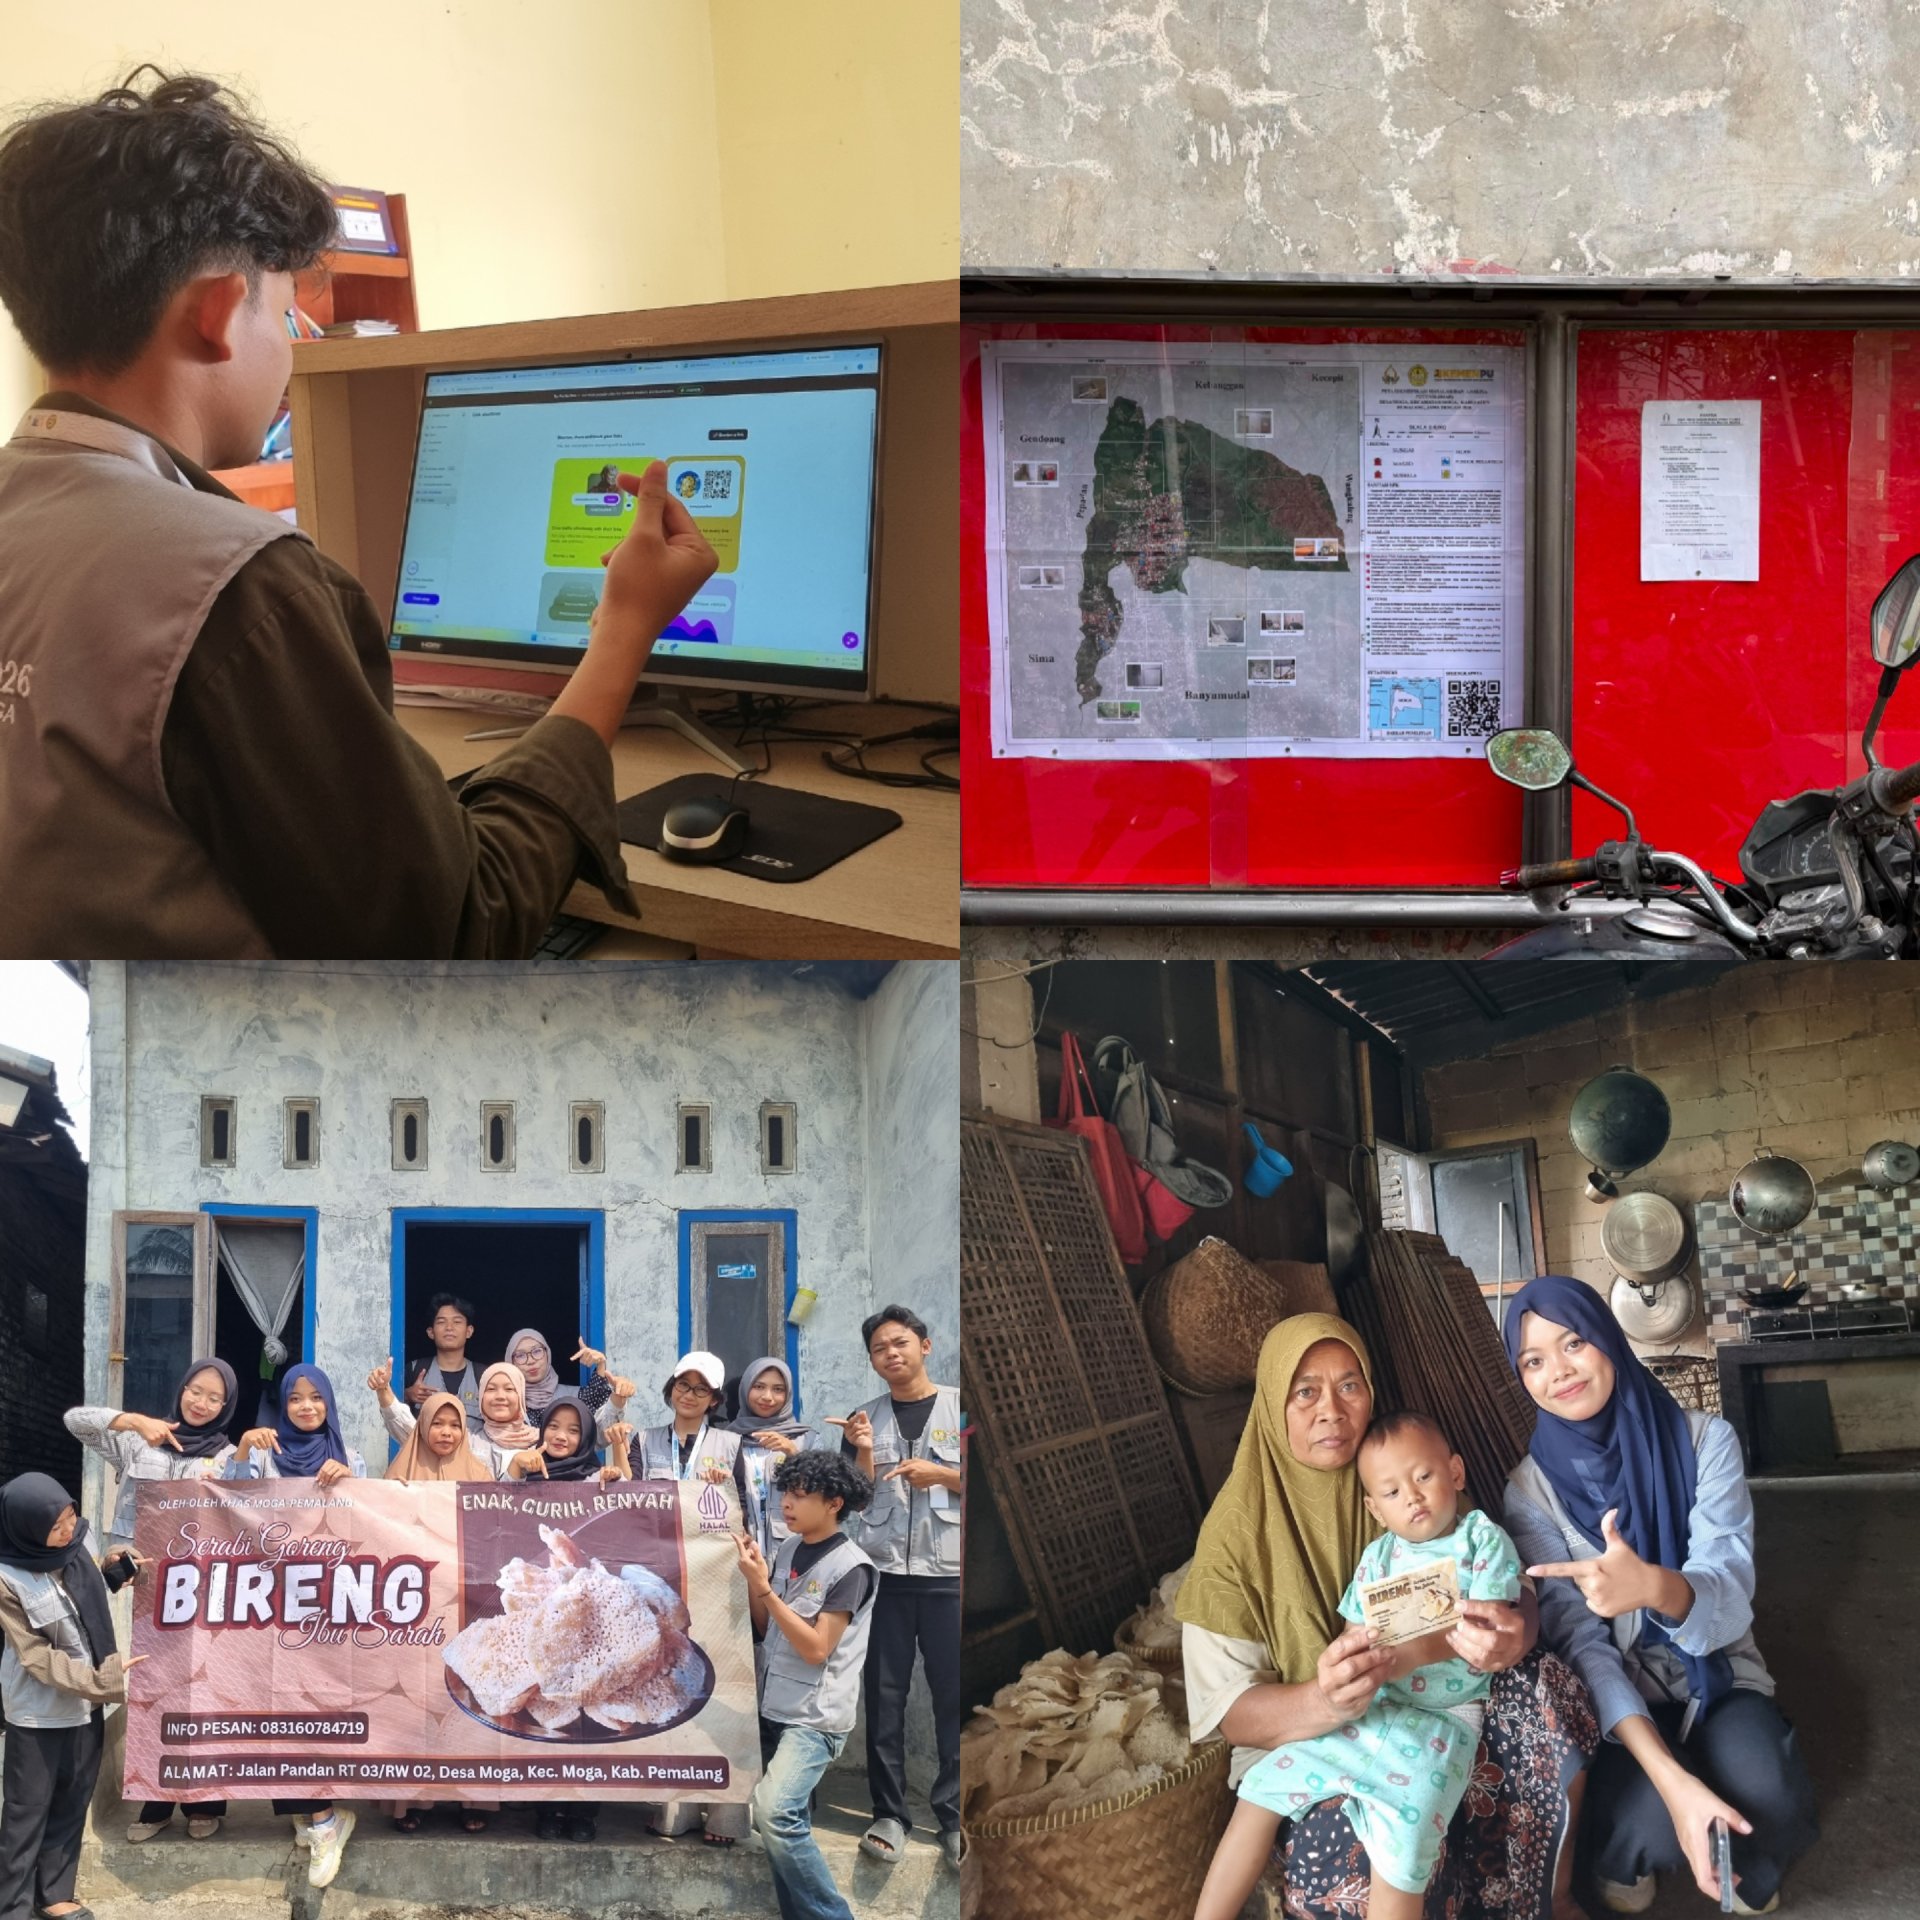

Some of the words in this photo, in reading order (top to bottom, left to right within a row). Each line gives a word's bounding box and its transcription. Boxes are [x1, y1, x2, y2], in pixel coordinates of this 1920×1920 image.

[1028, 654, 1055, 663] Sima
[159, 1497, 217, 1509] OLEH-OLEH
[221, 1498, 250, 1508] KHAS
[462, 1493, 518, 1516] ENAK,
[521, 1498, 591, 1519] GURIH,
[593, 1492, 674, 1512] RENYAH
[167, 1522, 253, 1560] Serabi
[258, 1522, 352, 1571] Goreng
[162, 1562, 424, 1624] BIRENG
[278, 1609, 347, 1649] Ibu
[352, 1609, 446, 1649] Sarah
[167, 1723, 198, 1736] INFO
[202, 1721, 257, 1735] PESAN:
[260, 1721, 365, 1735] 083160784719
[163, 1764, 233, 1779] ALAMAT:
[236, 1763, 276, 1777] Jalan
[280, 1763, 334, 1777] Pandan
[338, 1764, 356, 1777] RT
[360, 1764, 409, 1778] 03/RW
[413, 1765, 436, 1780] 02,
[439, 1765, 475, 1779] Desa
[479, 1766, 524, 1782] Moga,
[527, 1765, 558, 1778] Kec.
[562, 1765, 607, 1781] Moga,
[611, 1765, 644, 1779] Kab.
[648, 1765, 724, 1782] Pemalang
